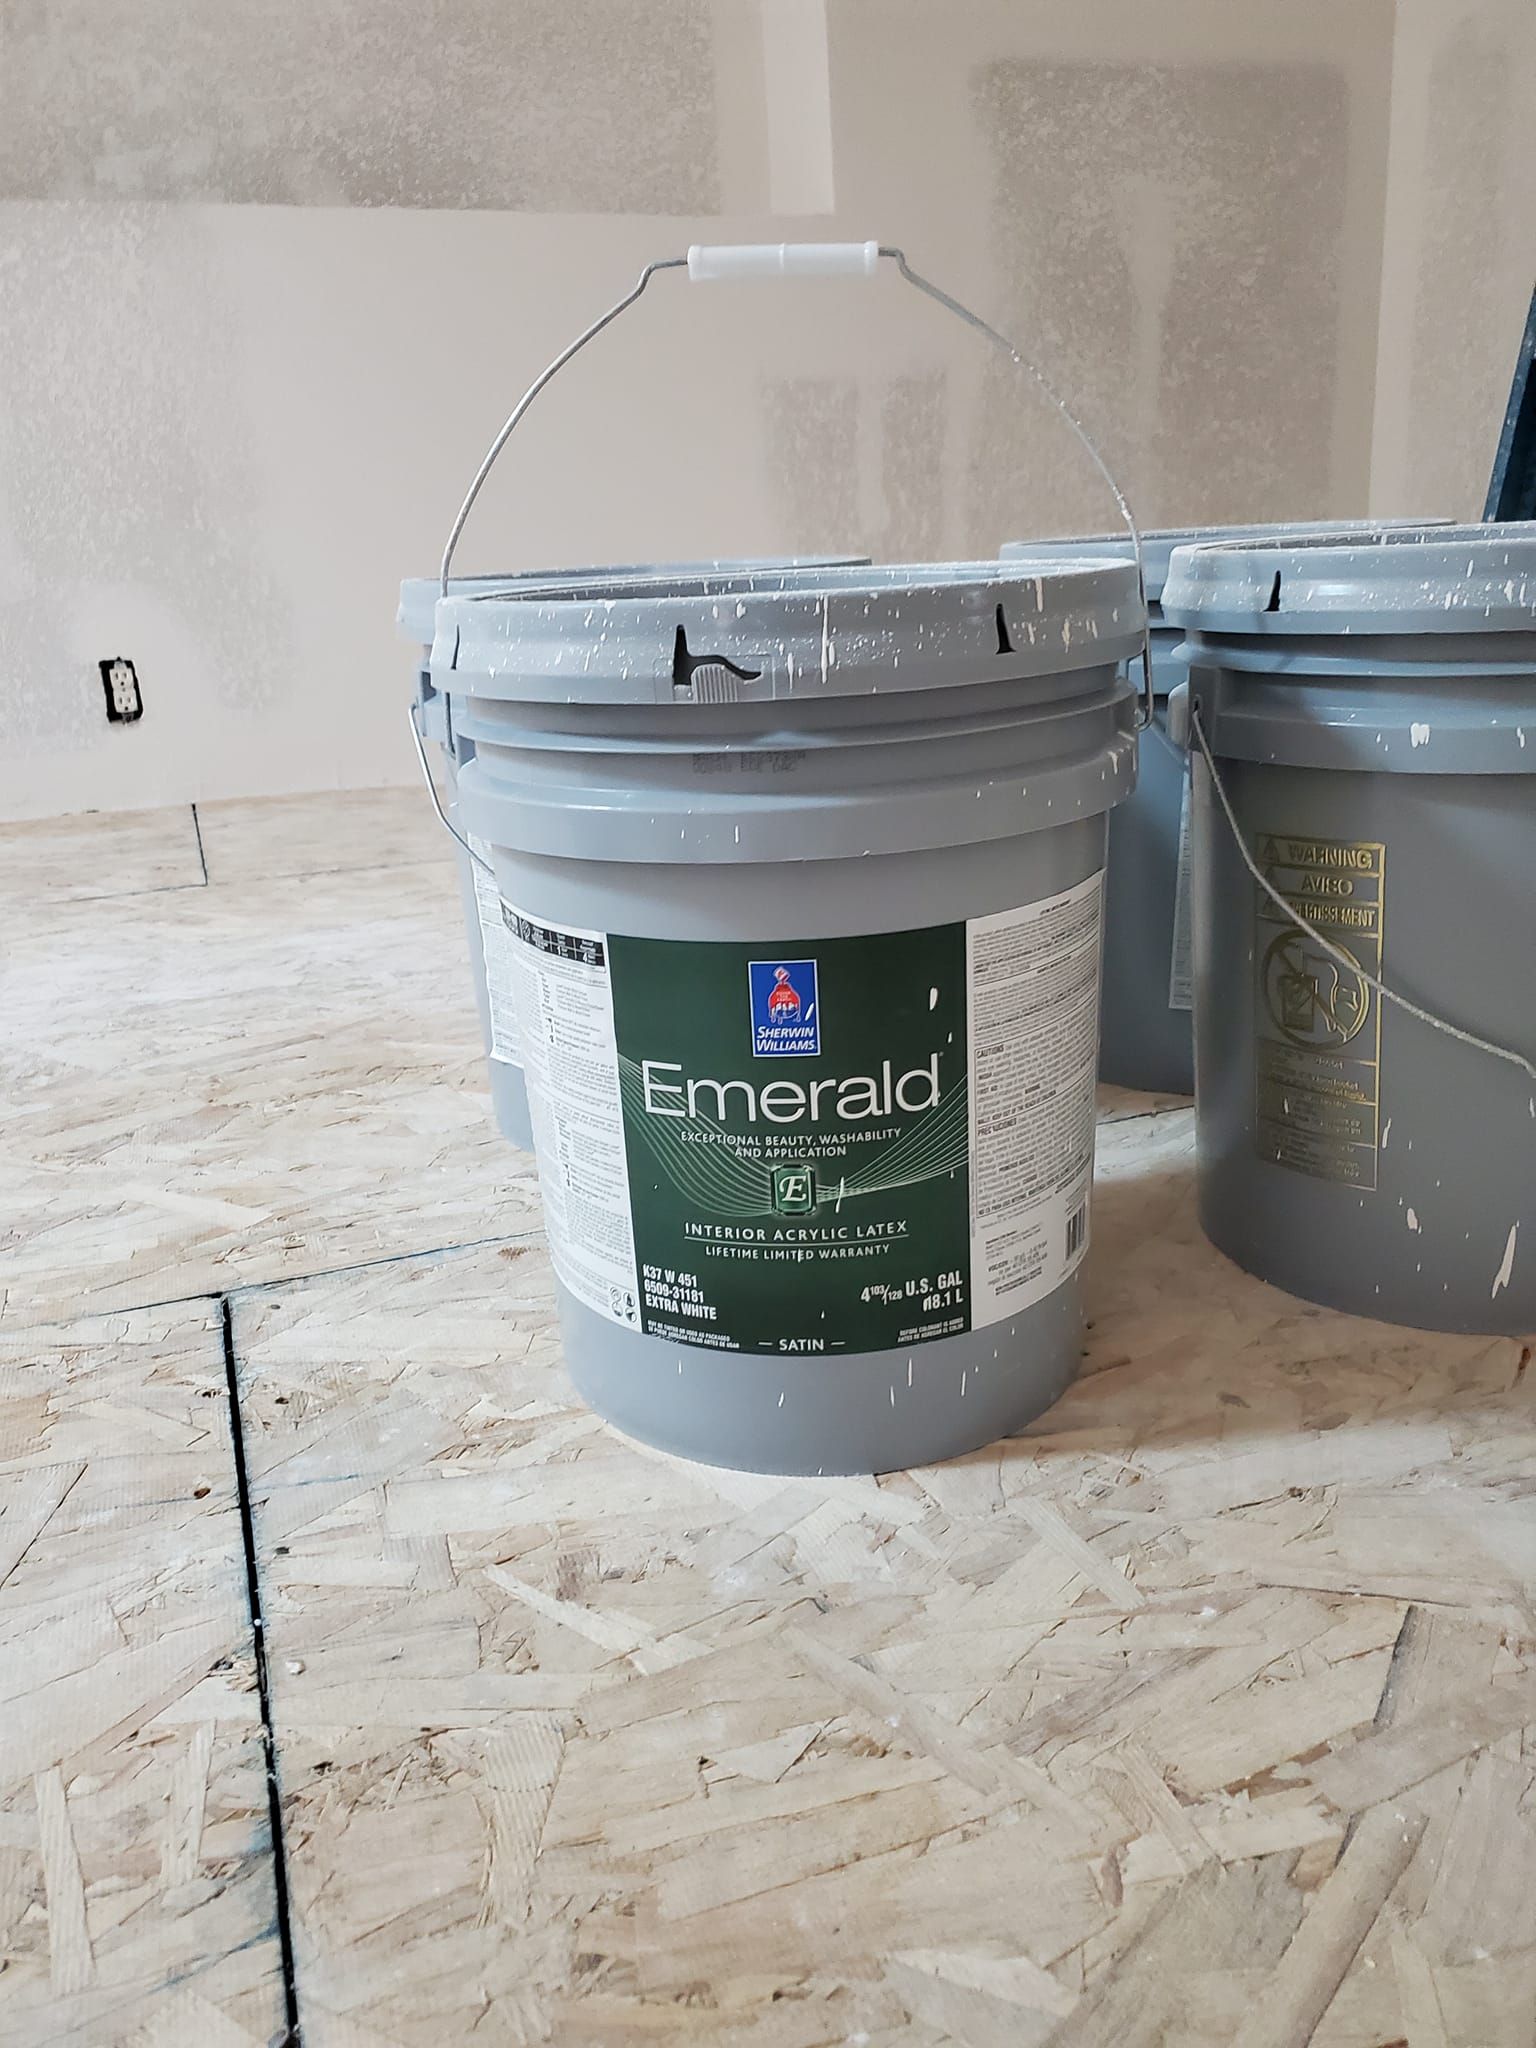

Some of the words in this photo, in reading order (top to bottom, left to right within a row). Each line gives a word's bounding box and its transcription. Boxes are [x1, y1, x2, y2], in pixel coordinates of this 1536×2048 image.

[1288, 843, 1372, 869] WARNING
[757, 1026, 814, 1038] SHERWIN
[756, 1039, 816, 1052] WILLIAMS
[642, 1053, 940, 1123] Emerald
[681, 1131, 760, 1146] EXCEPTIONAL
[765, 1136, 816, 1146] BEAUTY,
[819, 1128, 900, 1144] WASHABILITY
[734, 1146, 760, 1158] AND
[765, 1146, 846, 1158] APPLICATION
[779, 1176, 806, 1202] E
[685, 1222, 766, 1240] INTERIOR
[774, 1227, 848, 1240] ACRYLIC
[857, 1220, 906, 1238] LATEX
[706, 1246, 758, 1260] LIFETIME
[764, 1248, 814, 1260] LIMITED
[818, 1244, 890, 1259] WARRANTY
[643, 1264, 662, 1280] K37
[664, 1270, 675, 1284] W
[678, 1273, 697, 1288] 451
[906, 1278, 933, 1296] U.S.
[938, 1270, 963, 1290] GAL
[644, 1279, 704, 1304] 6509-31181
[956, 1288, 964, 1303] L
[646, 1294, 679, 1314] EXTRA
[681, 1302, 717, 1320] WHITE
[779, 1339, 824, 1350] SATIN
